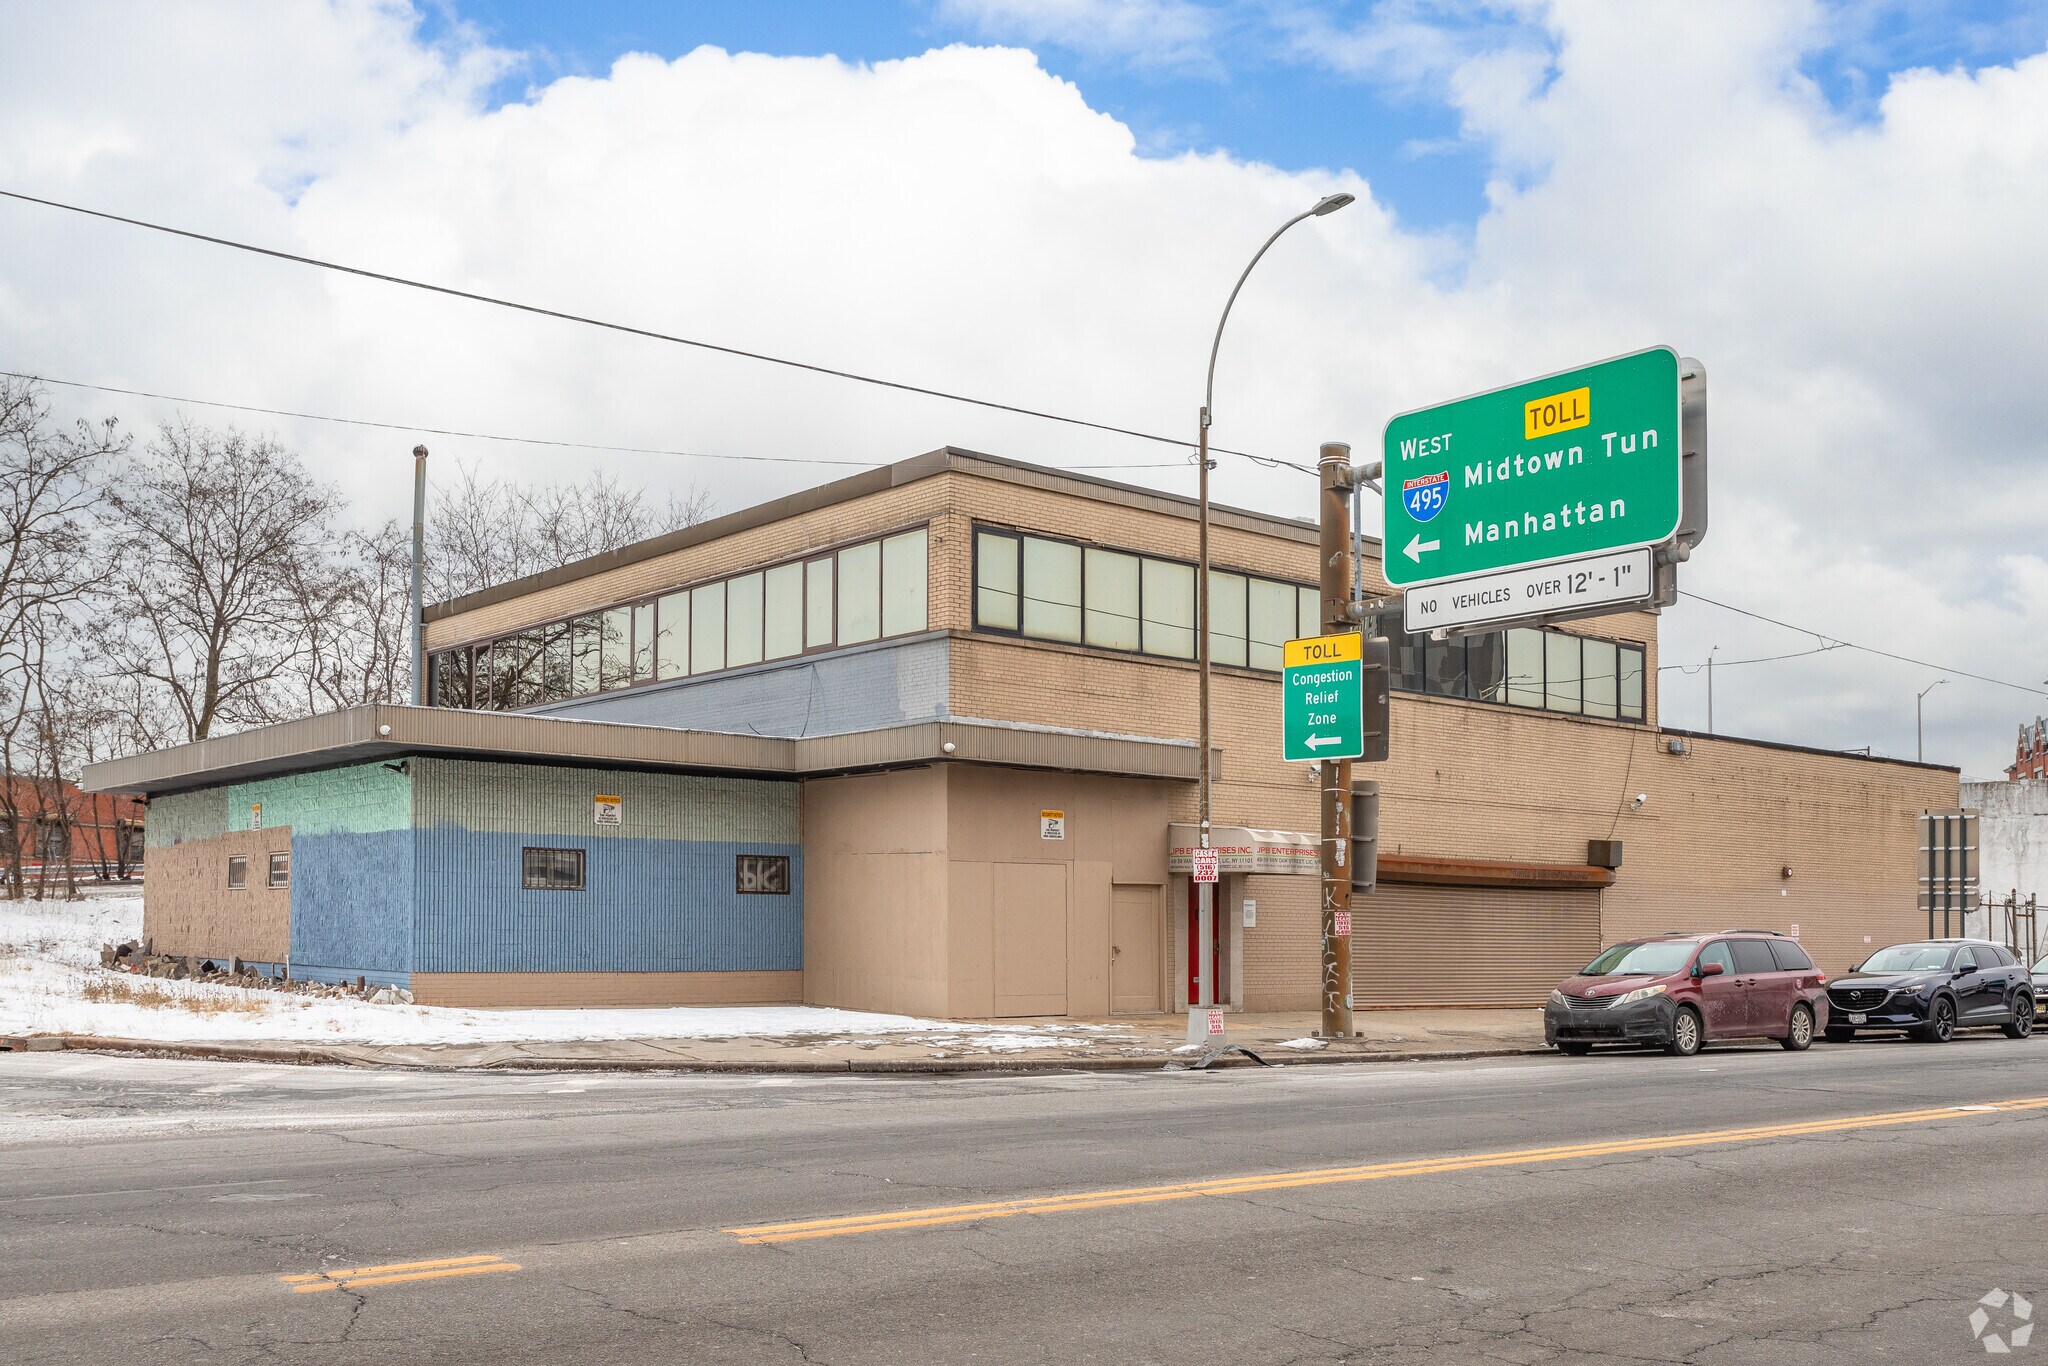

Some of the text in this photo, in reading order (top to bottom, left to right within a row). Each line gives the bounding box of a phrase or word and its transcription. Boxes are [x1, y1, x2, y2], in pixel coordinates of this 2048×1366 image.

[1530, 398, 1586, 430] TOLL
[1400, 433, 1453, 461] WEST
[1464, 429, 1658, 488] Midtown Tun
[1407, 473, 1445, 488] INTERSTATE
[1410, 486, 1442, 512] 495
[1465, 498, 1625, 546] Manhattan
[1420, 600, 1437, 614] NO
[1452, 588, 1511, 610] VEHICLES
[1526, 579, 1561, 598] OVER
[1304, 643, 1342, 660] TOLL
[1292, 669, 1353, 688] Congestion
[1305, 690, 1339, 705] Relief
[1307, 712, 1337, 726] Zone
[1170, 847, 1185, 855] JPB
[1256, 846, 1271, 855] JPB
[1271, 847, 1319, 857] ENTERPRISES
